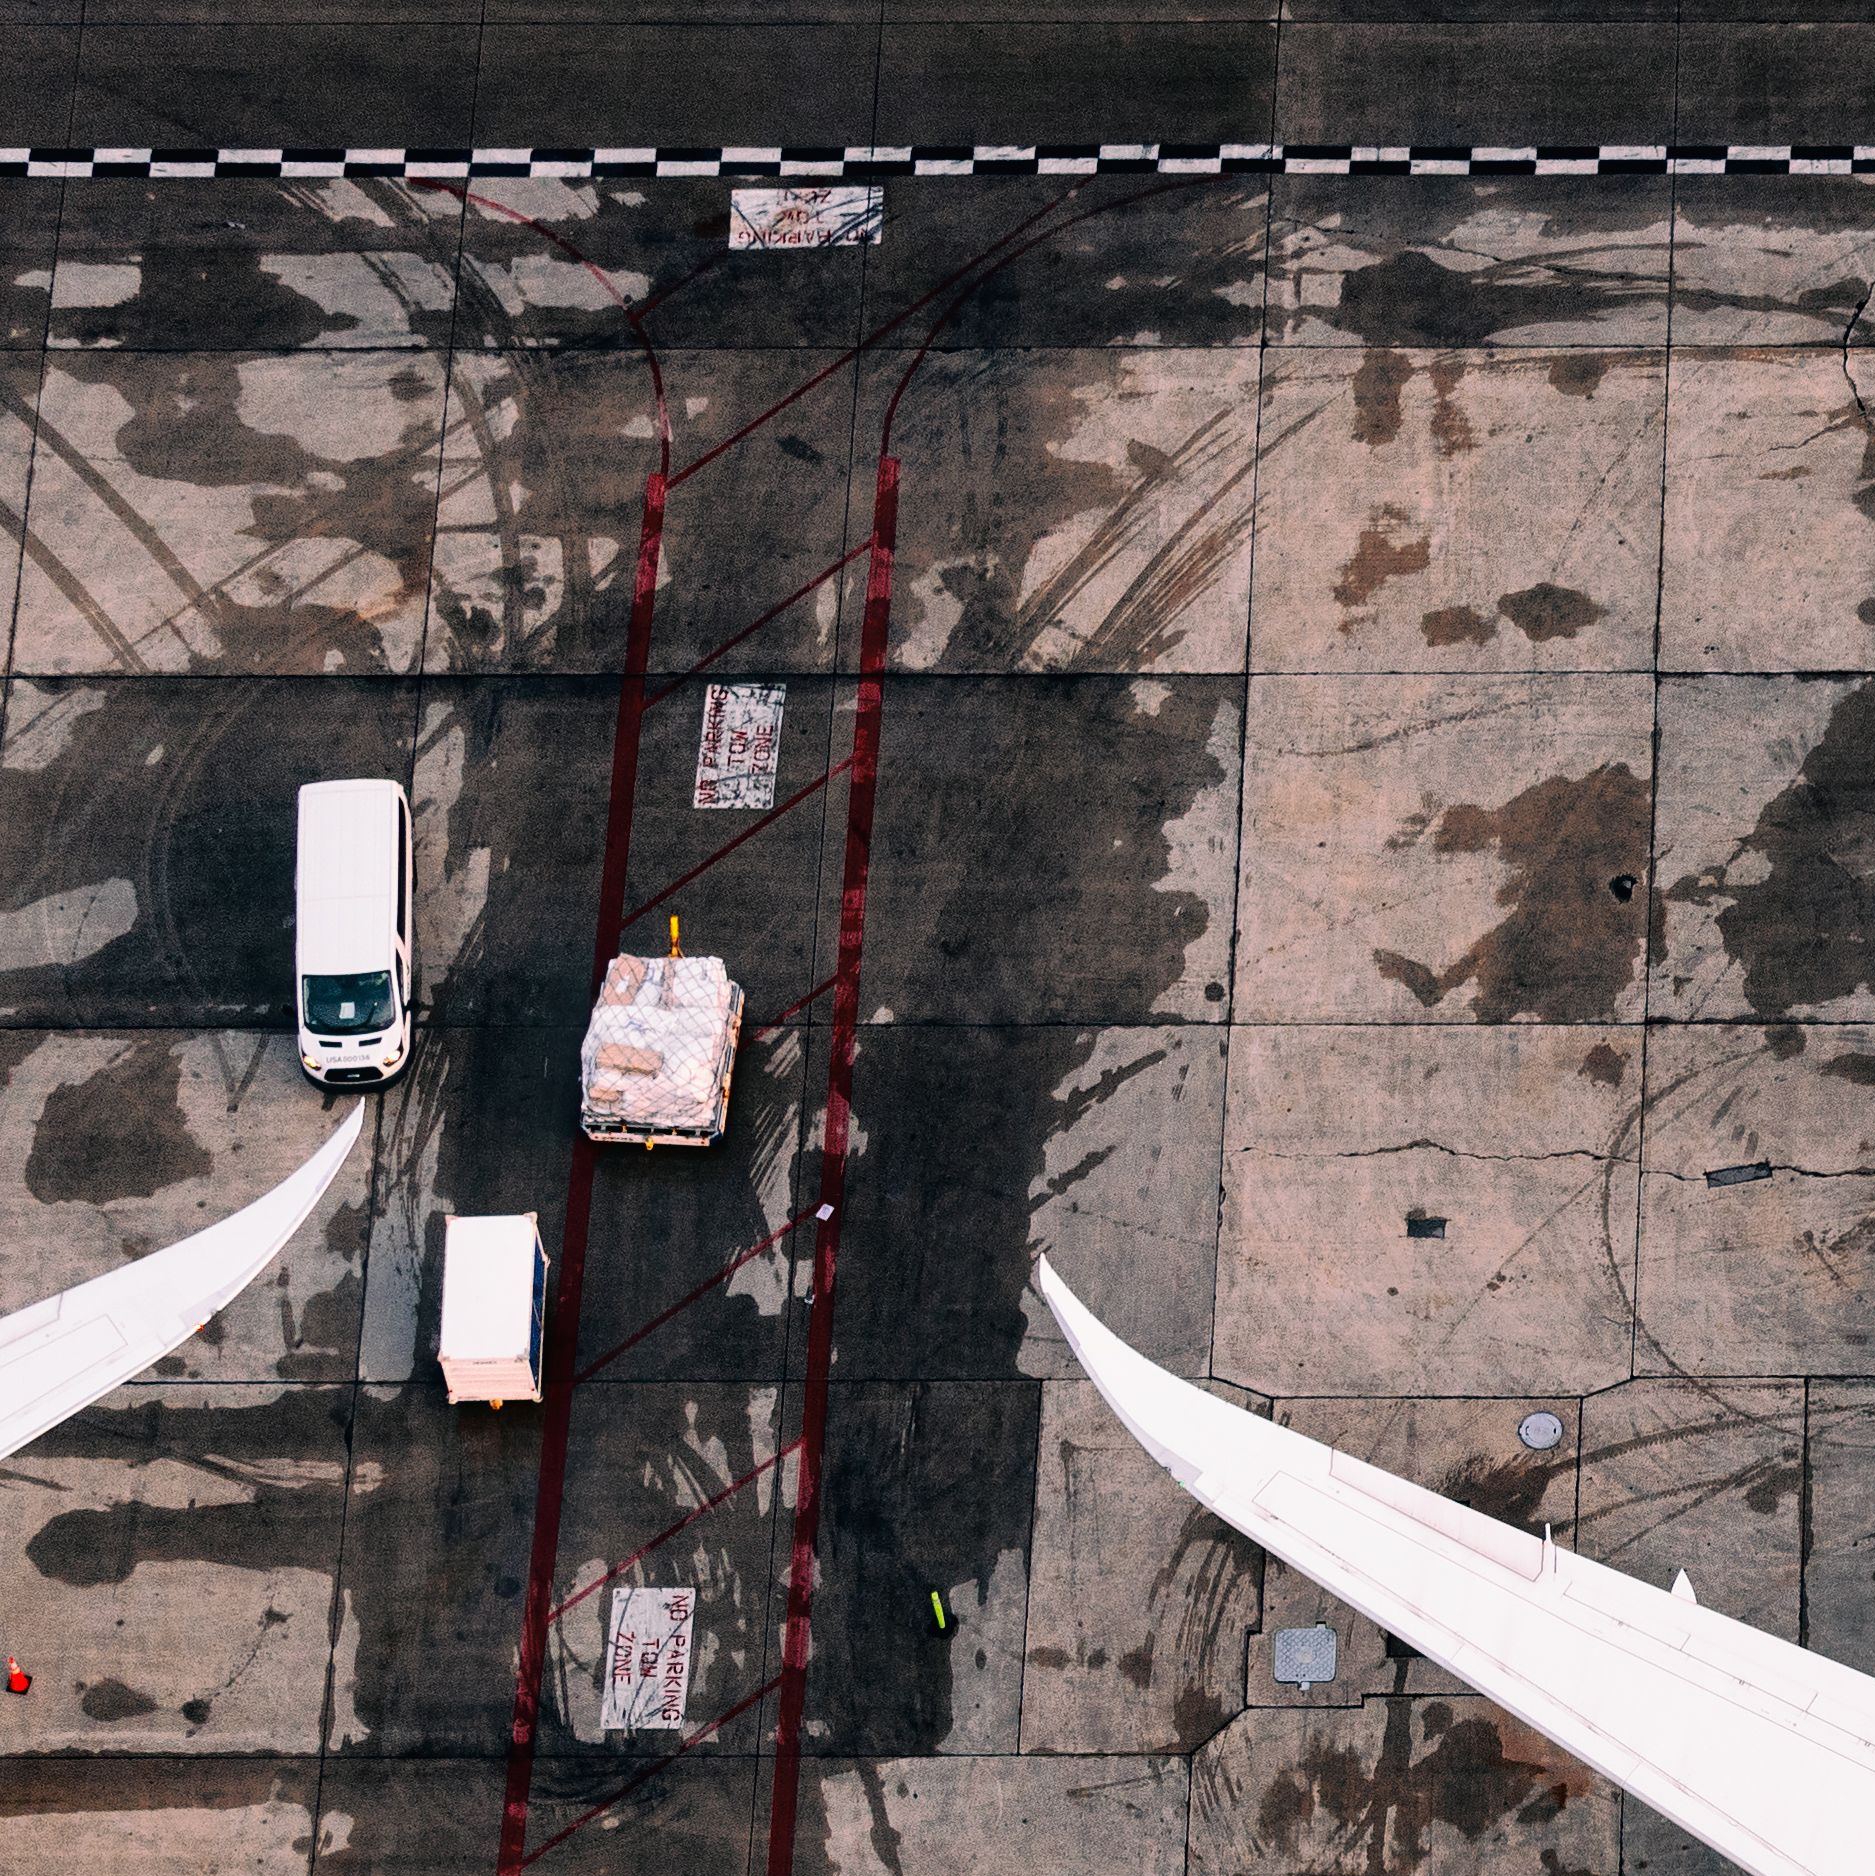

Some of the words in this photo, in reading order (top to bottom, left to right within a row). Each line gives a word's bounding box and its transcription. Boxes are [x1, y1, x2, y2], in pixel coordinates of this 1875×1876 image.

[703, 687, 729, 768] PARKING
[727, 730, 748, 767] TOW
[751, 725, 774, 774] ZONE
[670, 1595, 689, 1622] NO
[613, 1631, 636, 1685] ZONE
[640, 1638, 659, 1678] TOW
[662, 1635, 686, 1721] PARKING
